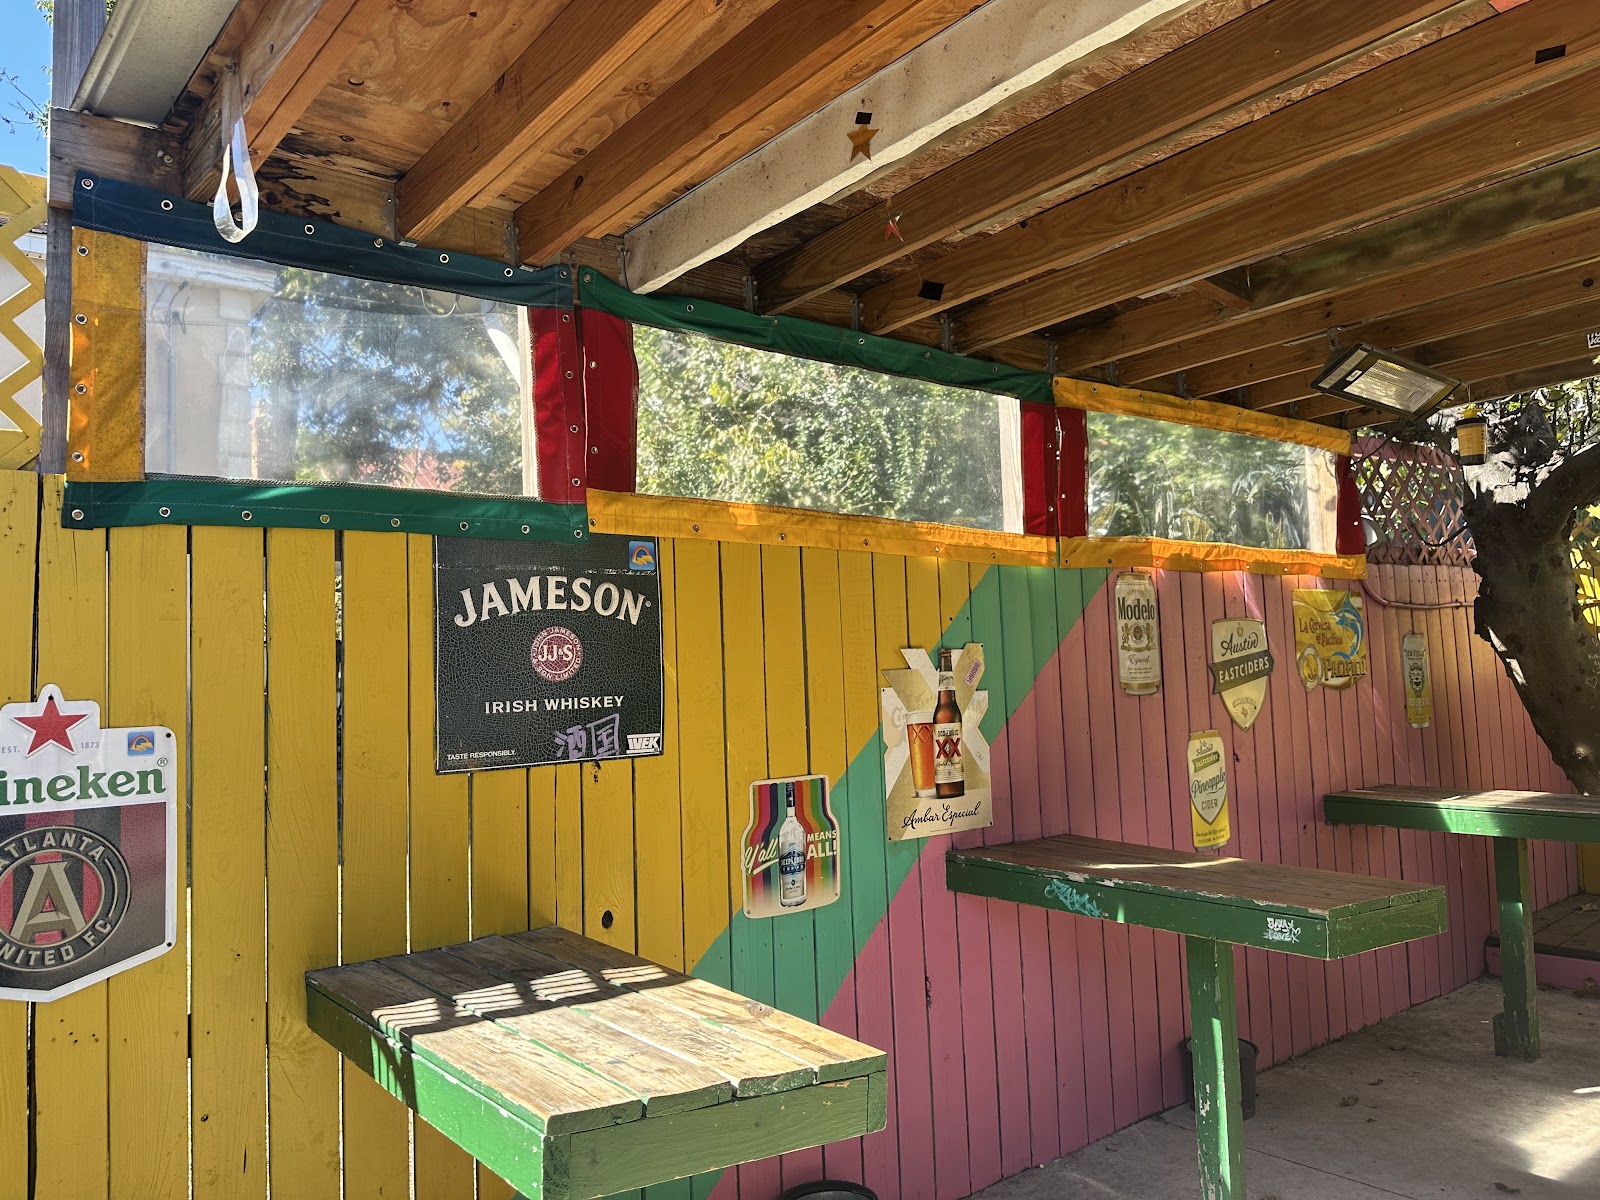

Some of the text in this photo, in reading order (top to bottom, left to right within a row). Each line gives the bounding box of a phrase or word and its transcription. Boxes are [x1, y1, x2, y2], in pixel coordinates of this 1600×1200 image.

[454, 575, 646, 627] JAMESON
[1117, 597, 1155, 620] Modelo
[1298, 617, 1309, 633] La
[549, 627, 581, 650] JAMESON
[1220, 631, 1259, 656] Austin
[537, 644, 573, 662] JJ&S
[555, 657, 581, 681] LIMITED
[1219, 656, 1270, 683] EASTCIDERS
[485, 695, 625, 714] IRISH WHISKEY
[1, 745, 21, 754] EST.
[80, 741, 100, 749] 1873
[469, 749, 517, 759] RESPONSIBLY.
[935, 738, 962, 759] XX
[1190, 766, 1226, 798] Pineapple
[901, 800, 981, 829] Ambar Especial
[1201, 798, 1219, 811] CIDER
[807, 829, 837, 843] MEANS
[744, 837, 779, 875] Y'all
[806, 839, 838, 860] ALL!
[0, 919, 112, 966] NITED FC
